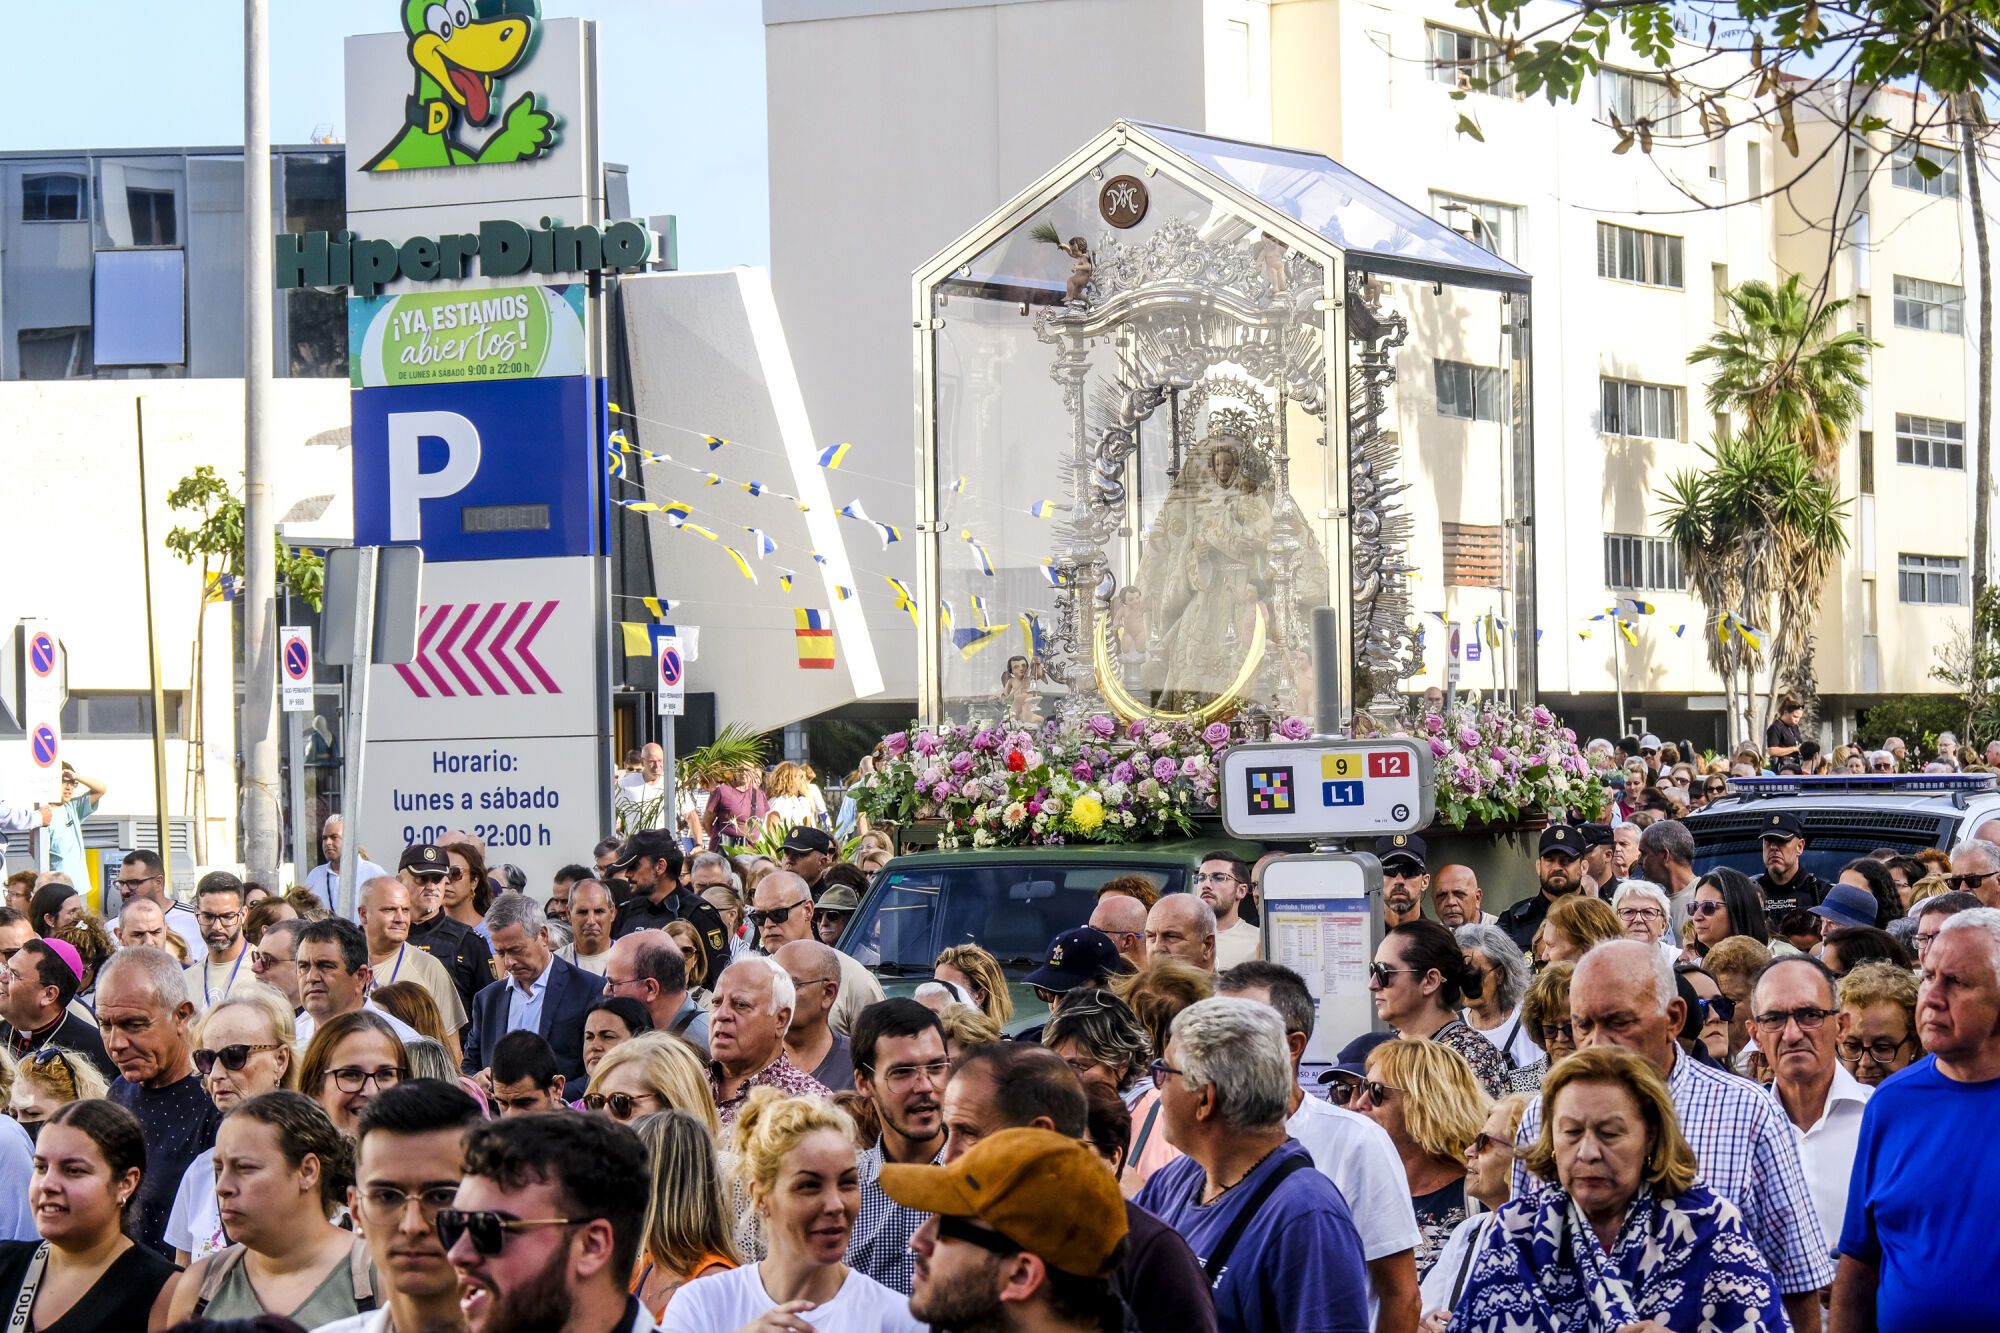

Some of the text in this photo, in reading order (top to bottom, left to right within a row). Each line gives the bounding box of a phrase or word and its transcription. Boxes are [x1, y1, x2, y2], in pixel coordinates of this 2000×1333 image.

[428, 102, 449, 134] D
[275, 215, 651, 296] HiperDino
[393, 294, 529, 341] ¡YA ESTAMOS
[400, 320, 528, 365] abiertos!
[399, 371, 407, 379] DE
[408, 370, 430, 379] LUNES
[432, 369, 437, 377] A
[438, 367, 465, 377] SÁBADO
[468, 364, 487, 375] 9:00
[497, 363, 522, 374] 22:00
[524, 362, 532, 373] h.
[388, 411, 481, 541] P
[433, 749, 518, 773] Horario:
[1336, 757, 1401, 775] 9 12
[393, 786, 559, 811] lunes a sábado
[1331, 785, 1354, 803] L1
[538, 824, 551, 846] h
[12, 1283, 36, 1326] TOUS
